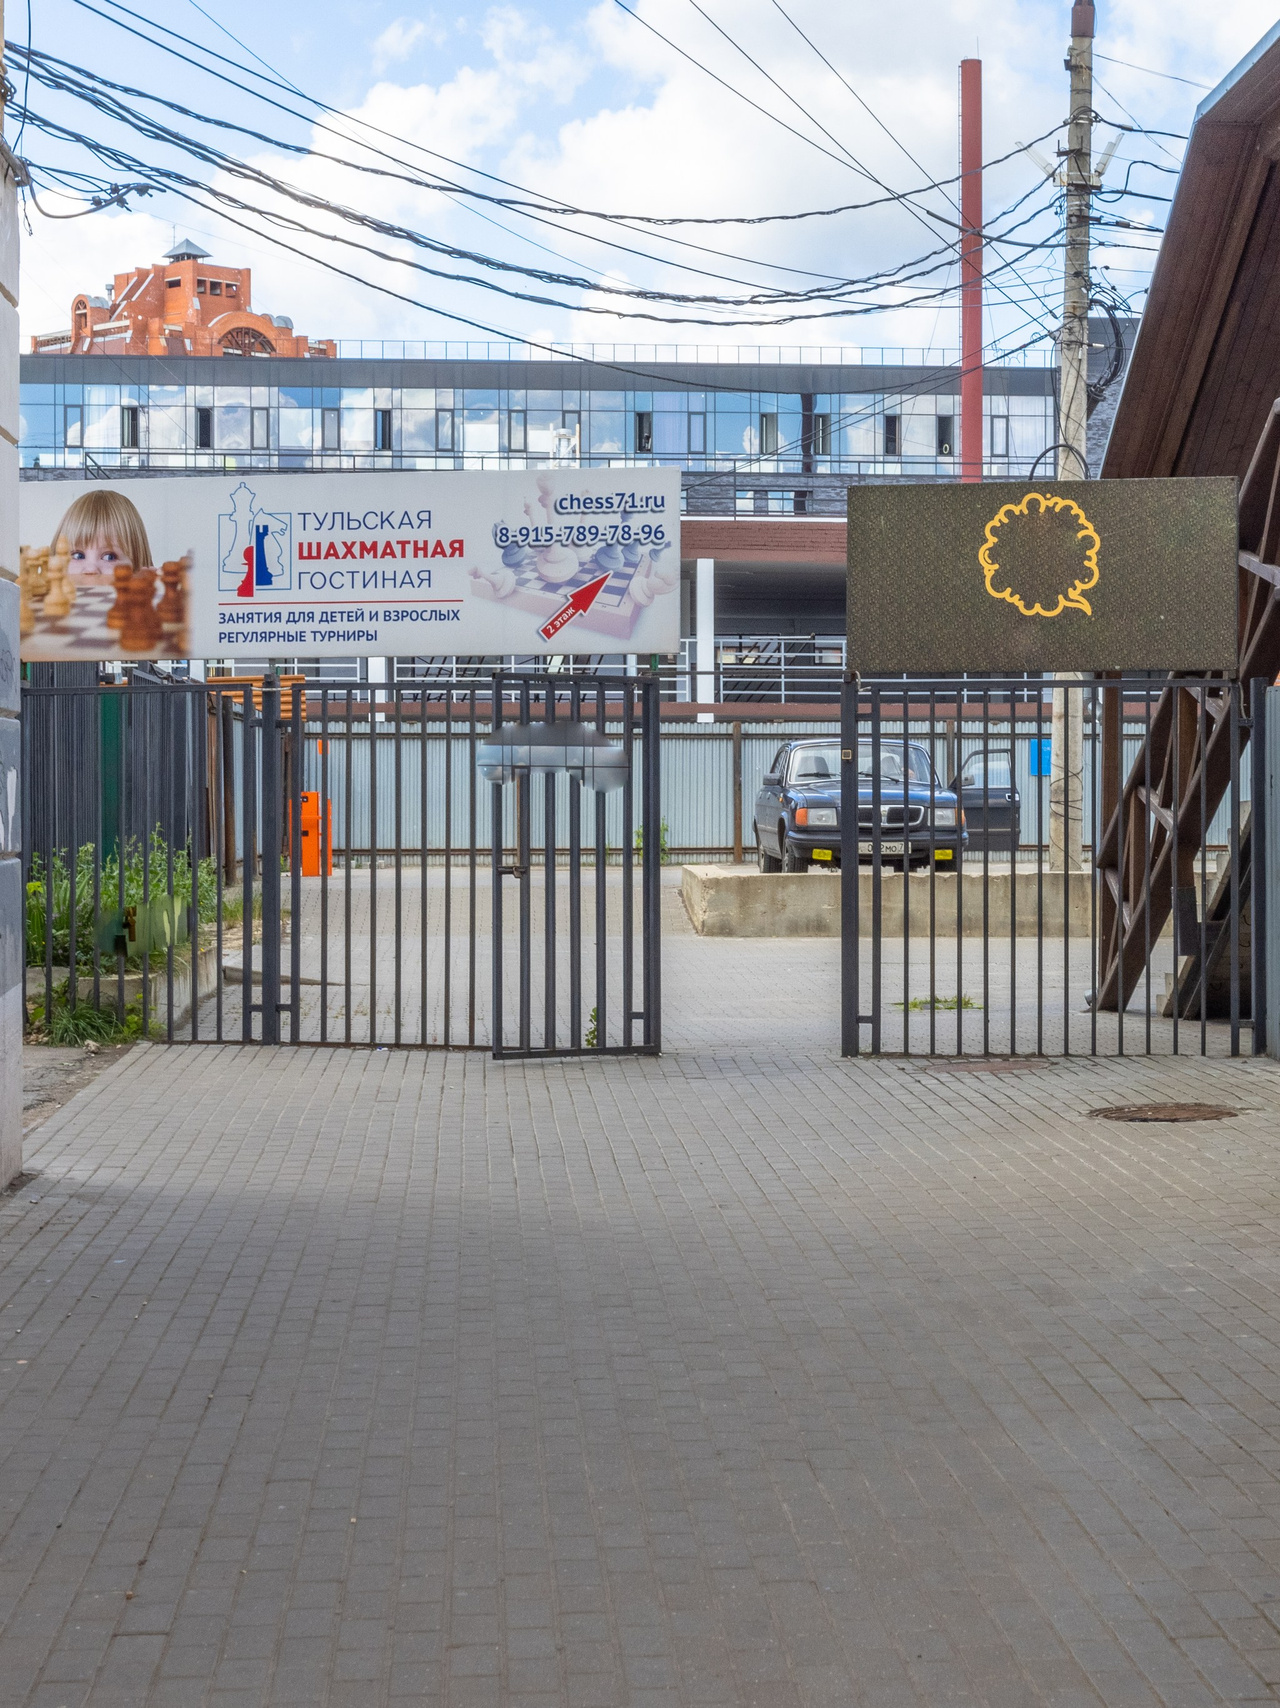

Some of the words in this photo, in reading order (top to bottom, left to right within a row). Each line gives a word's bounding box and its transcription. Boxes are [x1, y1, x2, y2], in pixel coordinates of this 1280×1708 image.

[558, 492, 666, 511] chess71.ru
[297, 510, 432, 531] ТУЛЬСКАЯ
[499, 524, 666, 543] 8-915-789-78-96
[298, 539, 464, 560] ШАХМАТНАЯ
[298, 569, 432, 590] ГОСТИНАЯ
[218, 612, 282, 624] ЗАНЯТИЯ
[286, 611, 315, 624] ДЛЯ
[318, 608, 365, 624] ДЕТЕЙ
[369, 610, 379, 622] И
[383, 609, 460, 622] ВЗРОСЛЫХ
[546, 625, 555, 634] 2
[553, 607, 576, 628] этаж
[218, 631, 307, 644] РЕГУЛЯРНЫЕ
[311, 630, 378, 643] ТУРНИРЫ
